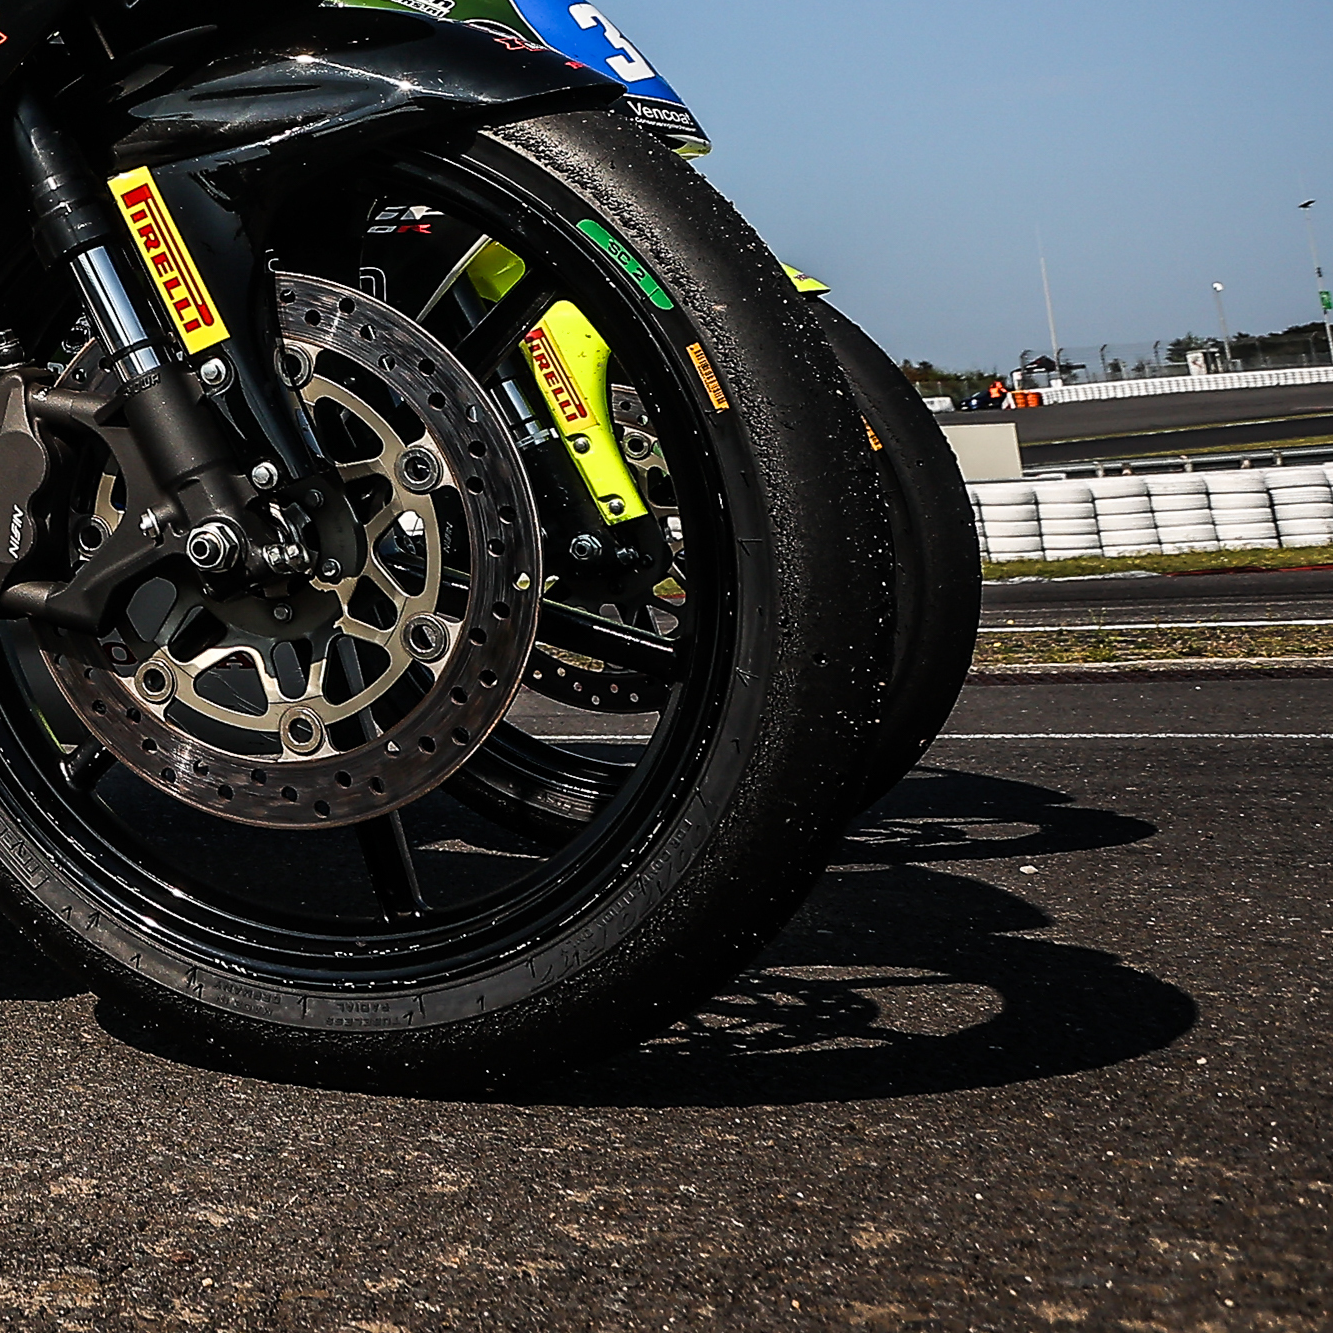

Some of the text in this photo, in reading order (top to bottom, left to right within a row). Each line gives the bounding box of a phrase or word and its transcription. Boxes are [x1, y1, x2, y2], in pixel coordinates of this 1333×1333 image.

[567, 2, 656, 83] 3
[120, 182, 216, 334] PIRELLI
[606, 237, 646, 282] SC 2
[524, 326, 588, 423] PIRELLI
